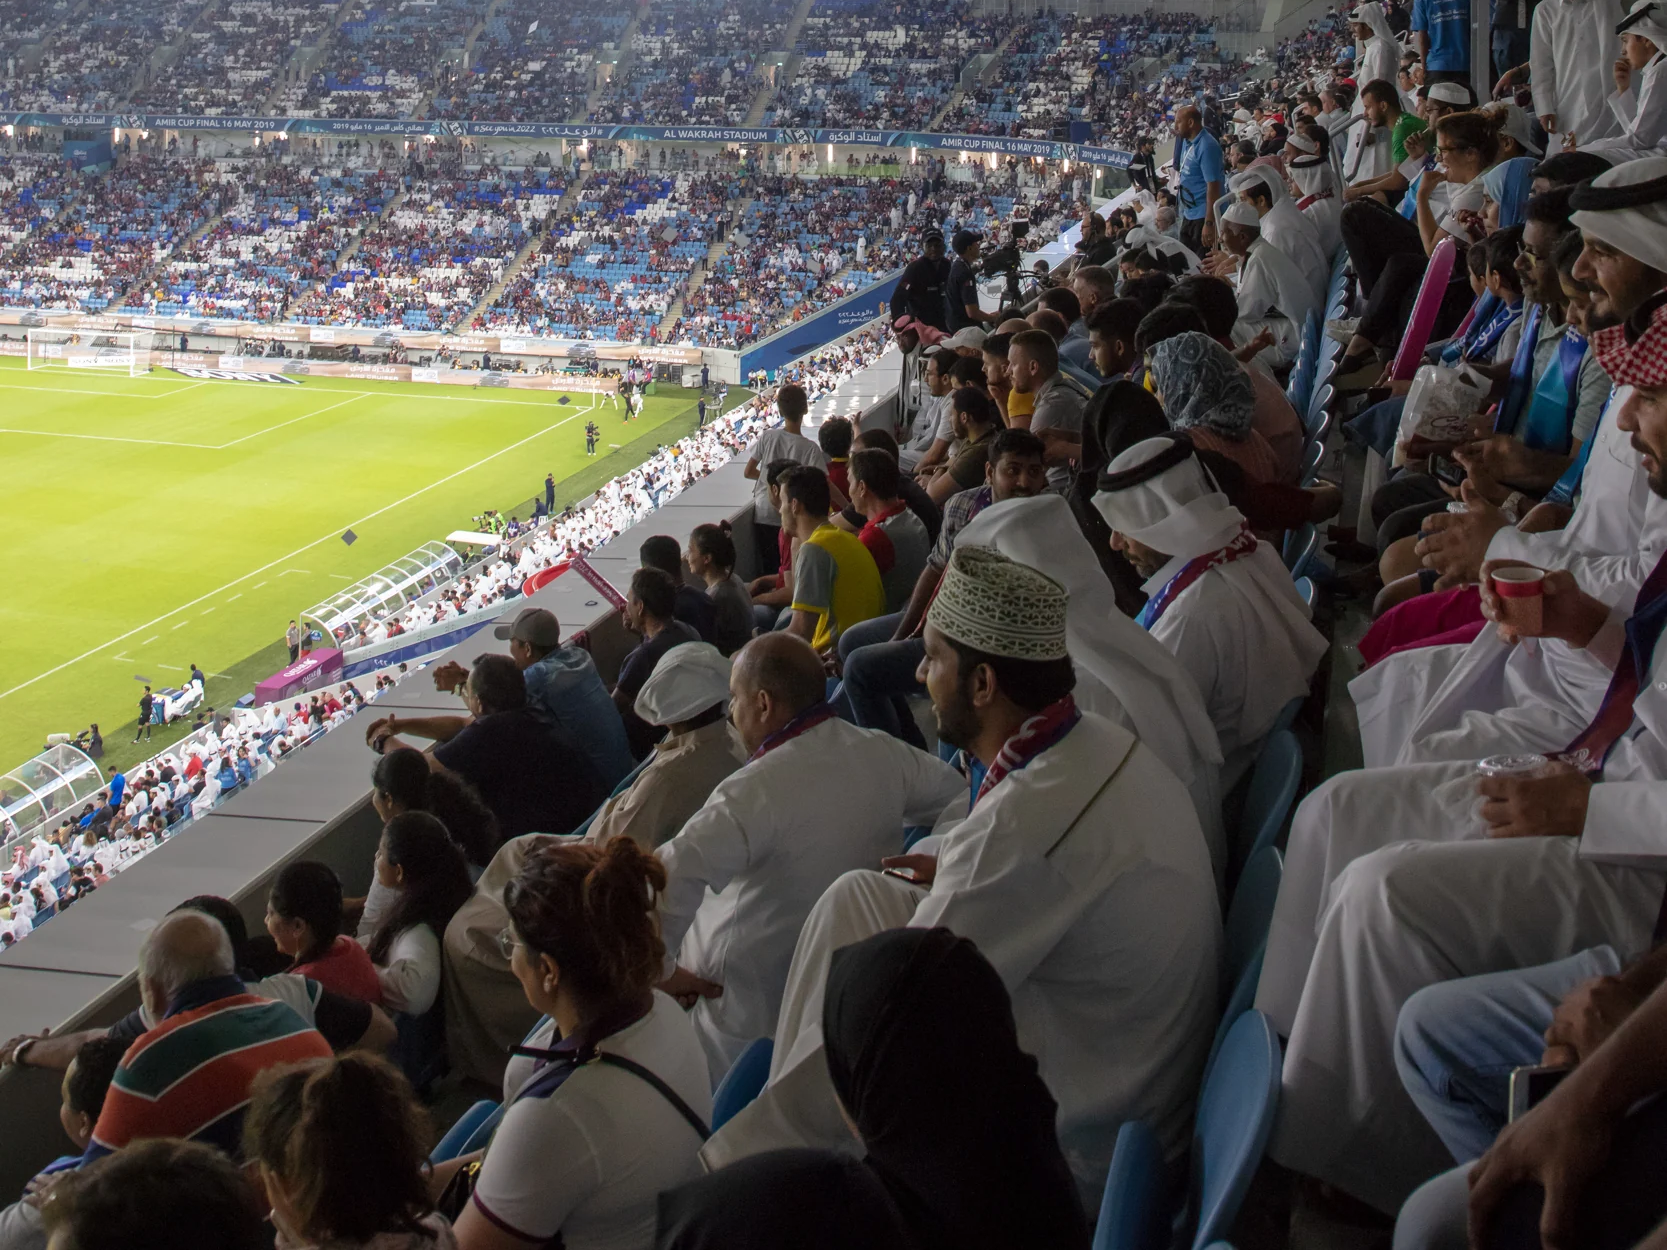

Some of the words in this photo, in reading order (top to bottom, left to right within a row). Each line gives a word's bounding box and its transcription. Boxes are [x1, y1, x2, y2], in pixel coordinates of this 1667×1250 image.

[62, 116, 84, 125] الوكرة
[85, 116, 106, 124] استاد
[155, 118, 176, 126] AMIR
[178, 119, 195, 127] CUP
[196, 119, 220, 127] FINAL
[664, 130, 676, 138] AL
[678, 130, 721, 139] WAKRAH
[724, 131, 768, 140] STADIUM
[828, 132, 855, 143] الوكرة
[857, 132, 882, 142] استاد
[941, 138, 962, 147] AMIR
[964, 140, 980, 148] CUP
[982, 140, 1004, 150] FINAL
[1007, 143, 1016, 151] 16
[1017, 144, 1032, 152] MAY
[1033, 144, 1050, 154] 2019
[176, 368, 281, 382] SONY
[302, 670, 317, 684] QATAR
